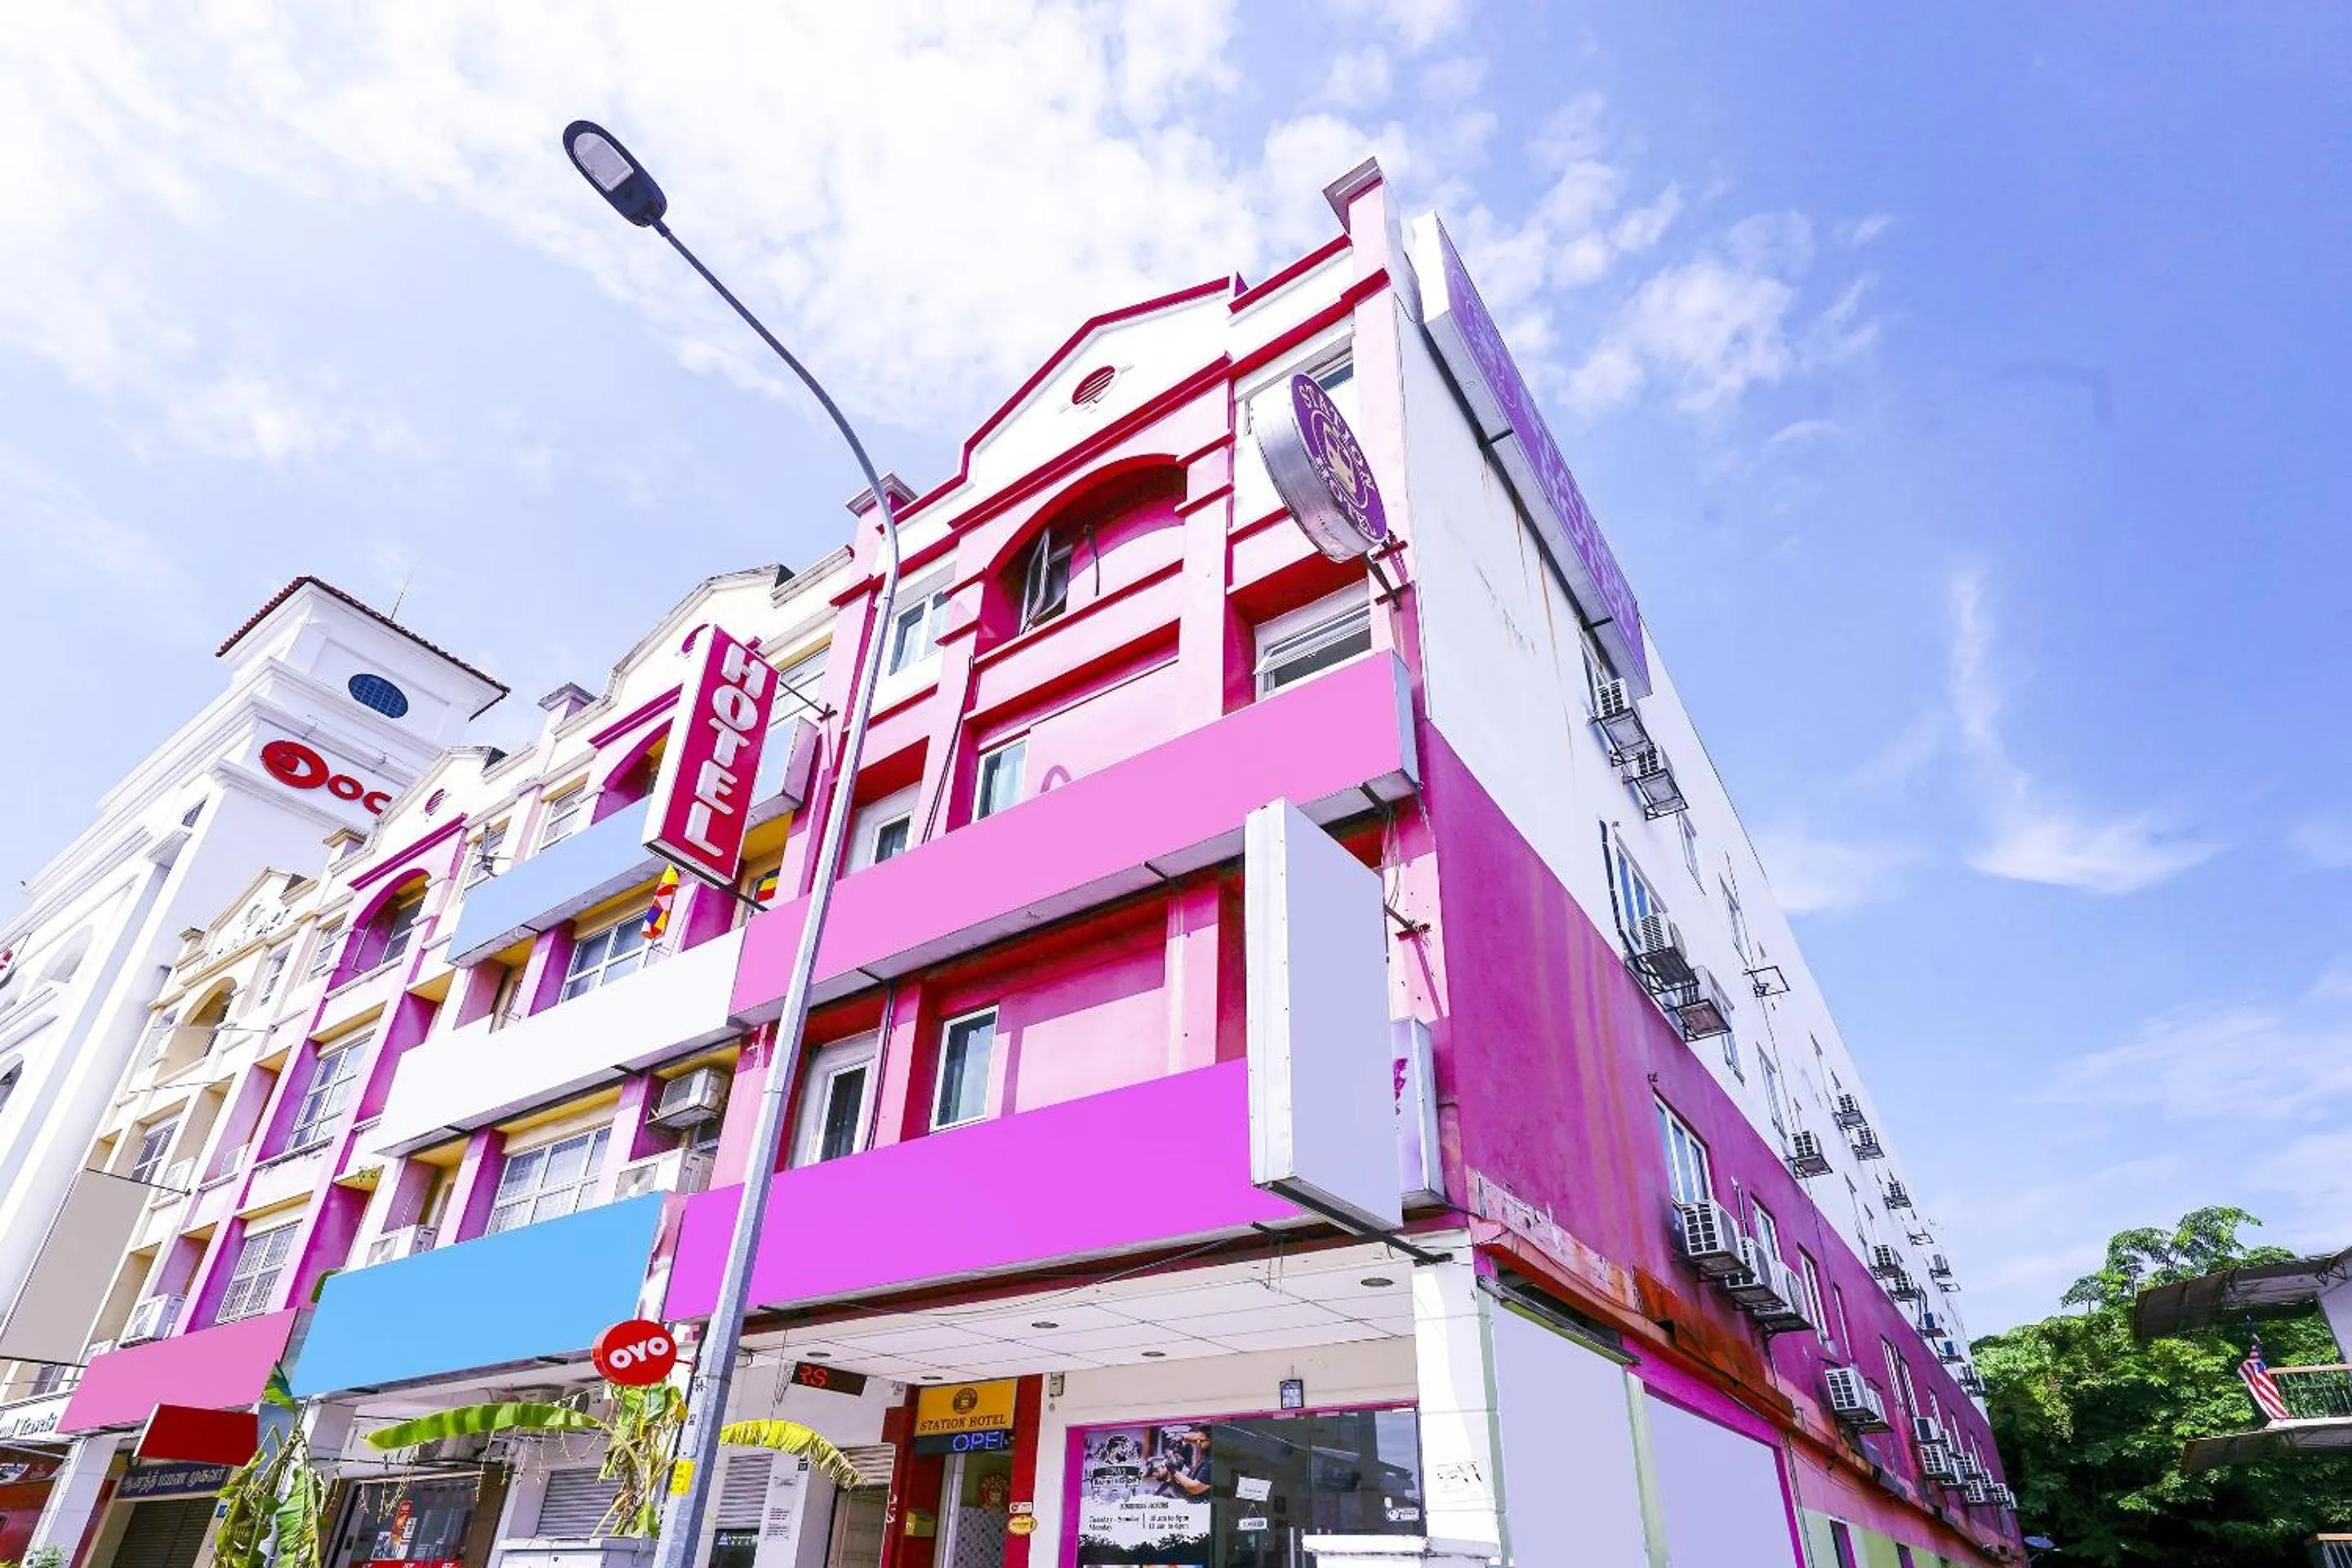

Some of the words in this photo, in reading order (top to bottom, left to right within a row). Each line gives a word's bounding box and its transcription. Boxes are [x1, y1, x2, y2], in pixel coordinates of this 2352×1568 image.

[684, 642, 767, 857] HOTEL
[609, 1337, 669, 1369] OYO
[920, 1417, 966, 1431] STATION
[969, 1414, 1006, 1428] HOTEL
